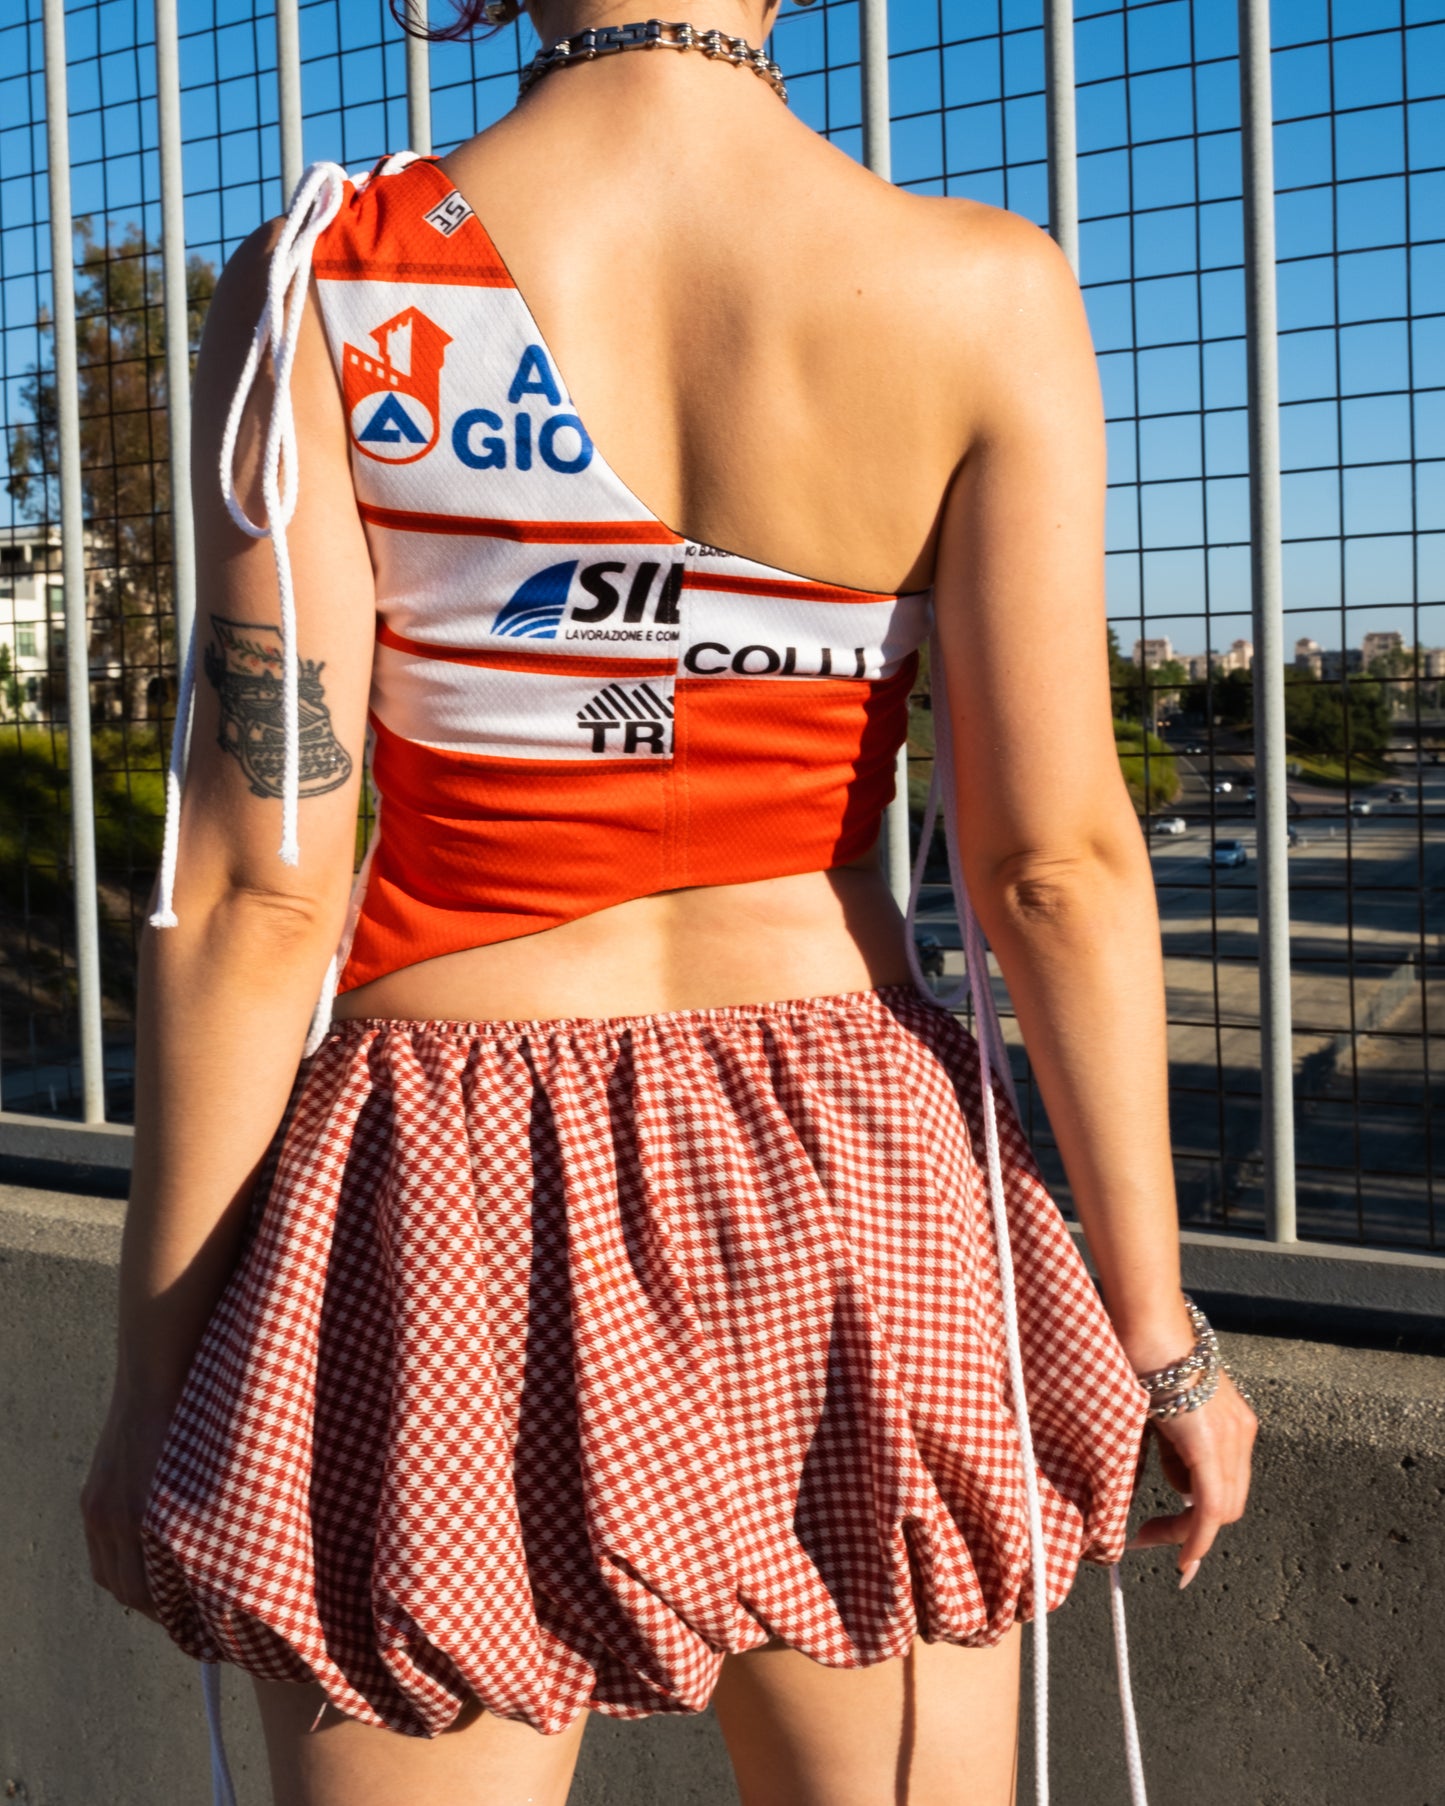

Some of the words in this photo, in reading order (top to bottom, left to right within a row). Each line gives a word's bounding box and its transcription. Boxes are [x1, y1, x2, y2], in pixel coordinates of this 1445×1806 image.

[451, 408, 593, 474] GIO
[565, 629, 643, 641] LAVORAZIONE
[646, 631, 653, 641] E
[577, 722, 675, 755] TR
